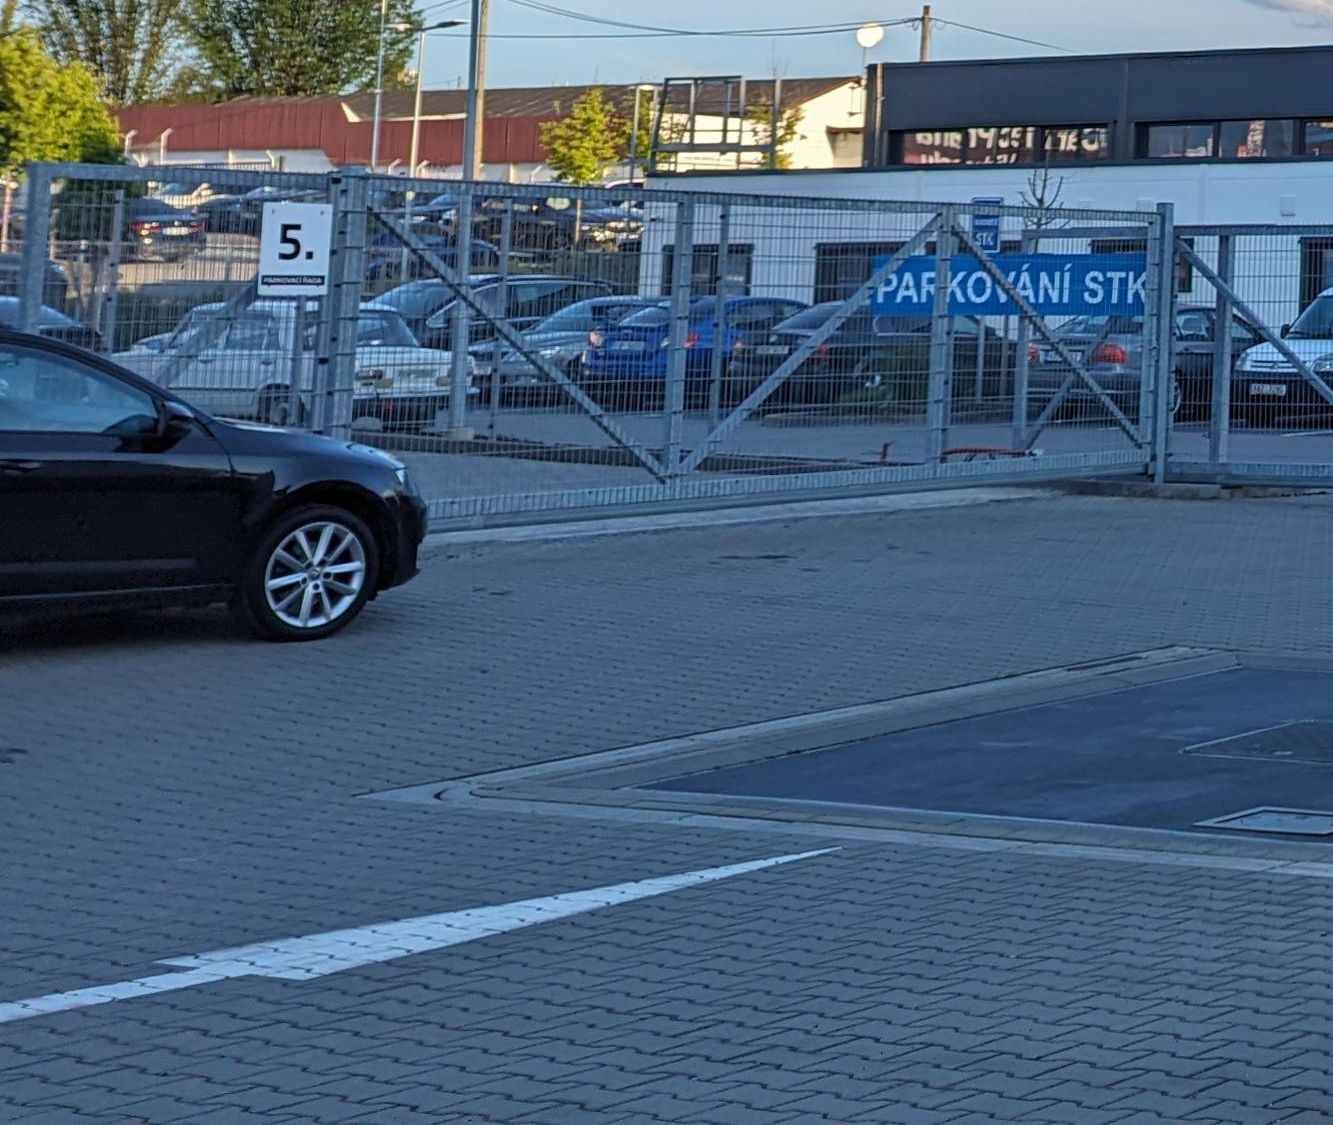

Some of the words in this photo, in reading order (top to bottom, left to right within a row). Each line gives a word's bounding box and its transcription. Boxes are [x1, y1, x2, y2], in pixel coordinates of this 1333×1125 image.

[278, 223, 314, 260] 5.
[877, 263, 1072, 304] PARKOVÁNÍ
[1083, 270, 1147, 304] STK
